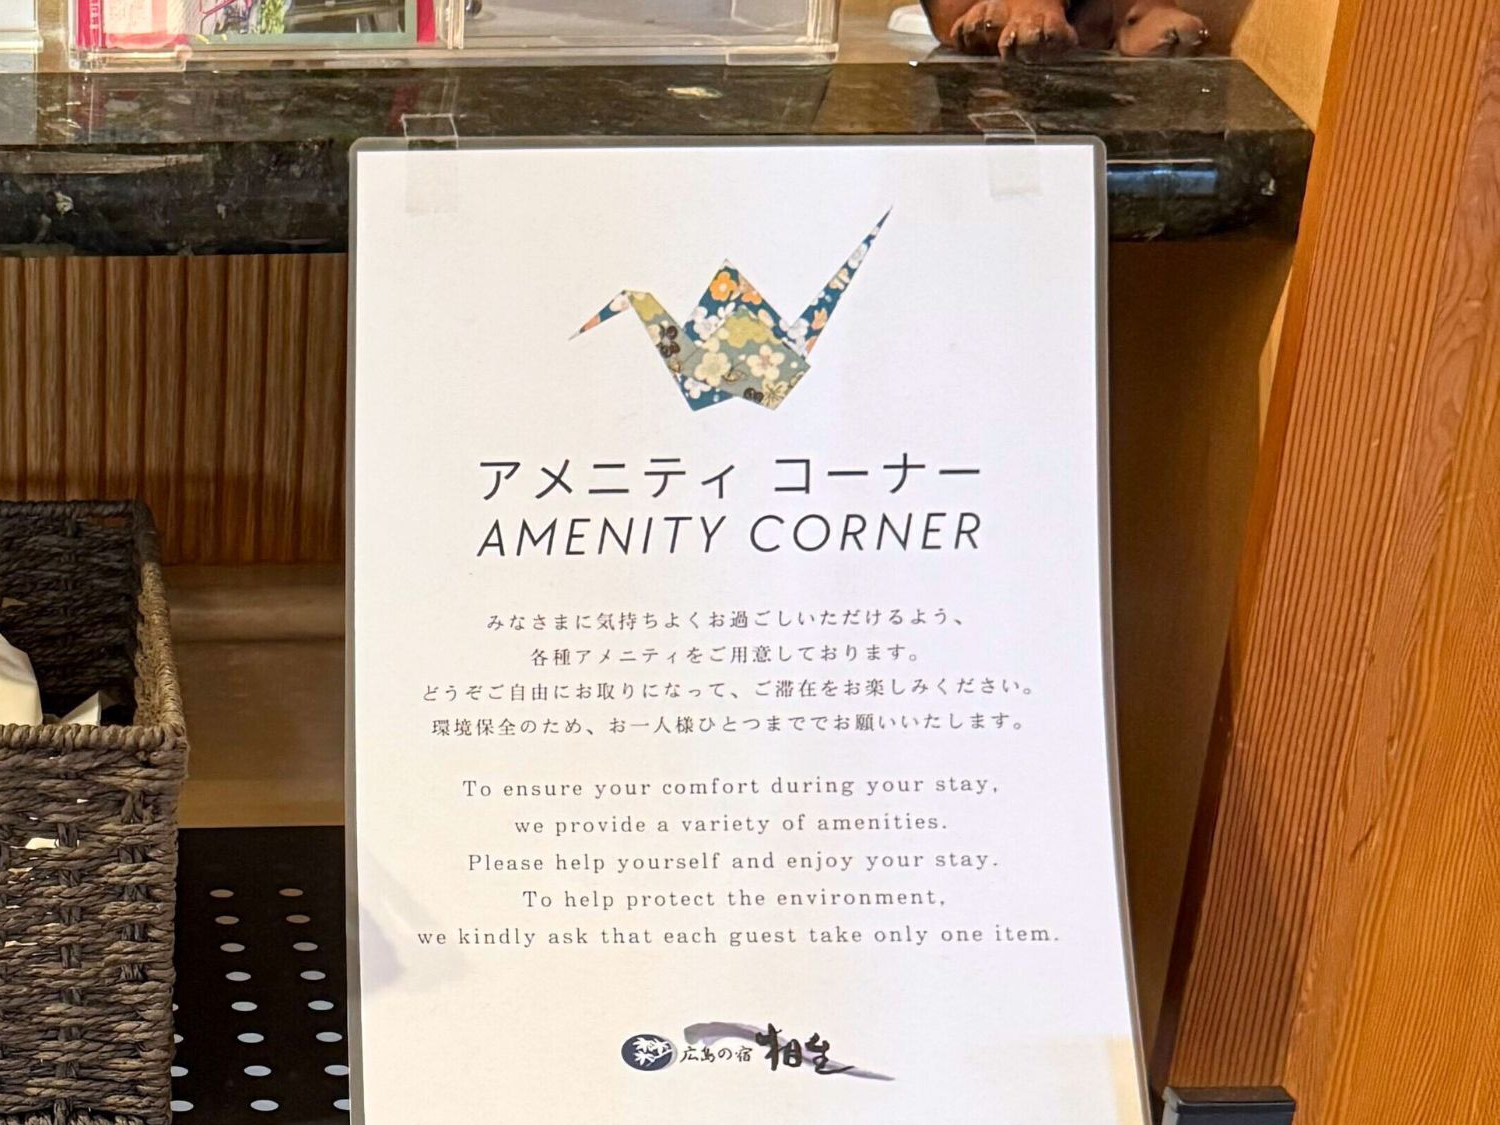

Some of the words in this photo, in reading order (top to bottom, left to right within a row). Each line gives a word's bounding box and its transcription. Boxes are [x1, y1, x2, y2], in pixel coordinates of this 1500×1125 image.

[479, 458, 737, 501] アメニティ
[772, 453, 982, 496] コーナー
[476, 514, 728, 557] AMENITY
[749, 511, 981, 553] CORNER
[486, 607, 966, 632] みなさまに気持ちよくお過ごしいただけるよう、
[530, 643, 919, 667] 各種アメニティをご用意しております。
[422, 676, 1034, 702] どうぞご自由にお取りになって、ご滞在をお楽しみください。
[431, 711, 1023, 737] 環境保全のため、お一人様ひとつまででお願いいたします。
[462, 779, 492, 797] To
[503, 784, 583, 797] ensure
[594, 783, 651, 800] your
[662, 777, 760, 796] comfort
[770, 775, 855, 797] during
[866, 780, 924, 797] your
[935, 776, 1000, 797] stay,
[514, 821, 544, 834] we
[555, 815, 646, 837] provide
[656, 820, 669, 833] a
[681, 813, 770, 836] variety
[782, 812, 806, 831] of
[817, 812, 948, 831] amenities.
[468, 853, 544, 872] Please
[555, 852, 605, 875] help
[617, 851, 721, 874] yourself
[731, 850, 775, 870] and
[786, 850, 854, 873] enjoy
[865, 855, 924, 872] your
[935, 852, 999, 871] stay.
[522, 890, 553, 908] To
[564, 889, 614, 911] help
[626, 891, 716, 911] protect
[727, 888, 766, 907] the
[776, 887, 947, 908] environment,
[417, 932, 447, 945] we
[458, 927, 536, 949] kindly
[548, 927, 589, 945] ask
[600, 926, 653, 944] that
[663, 926, 717, 944] each
[729, 928, 797, 947] guest
[809, 925, 862, 943] take
[873, 924, 928, 947] only
[940, 929, 983, 942] one
[995, 923, 1061, 943] item.
